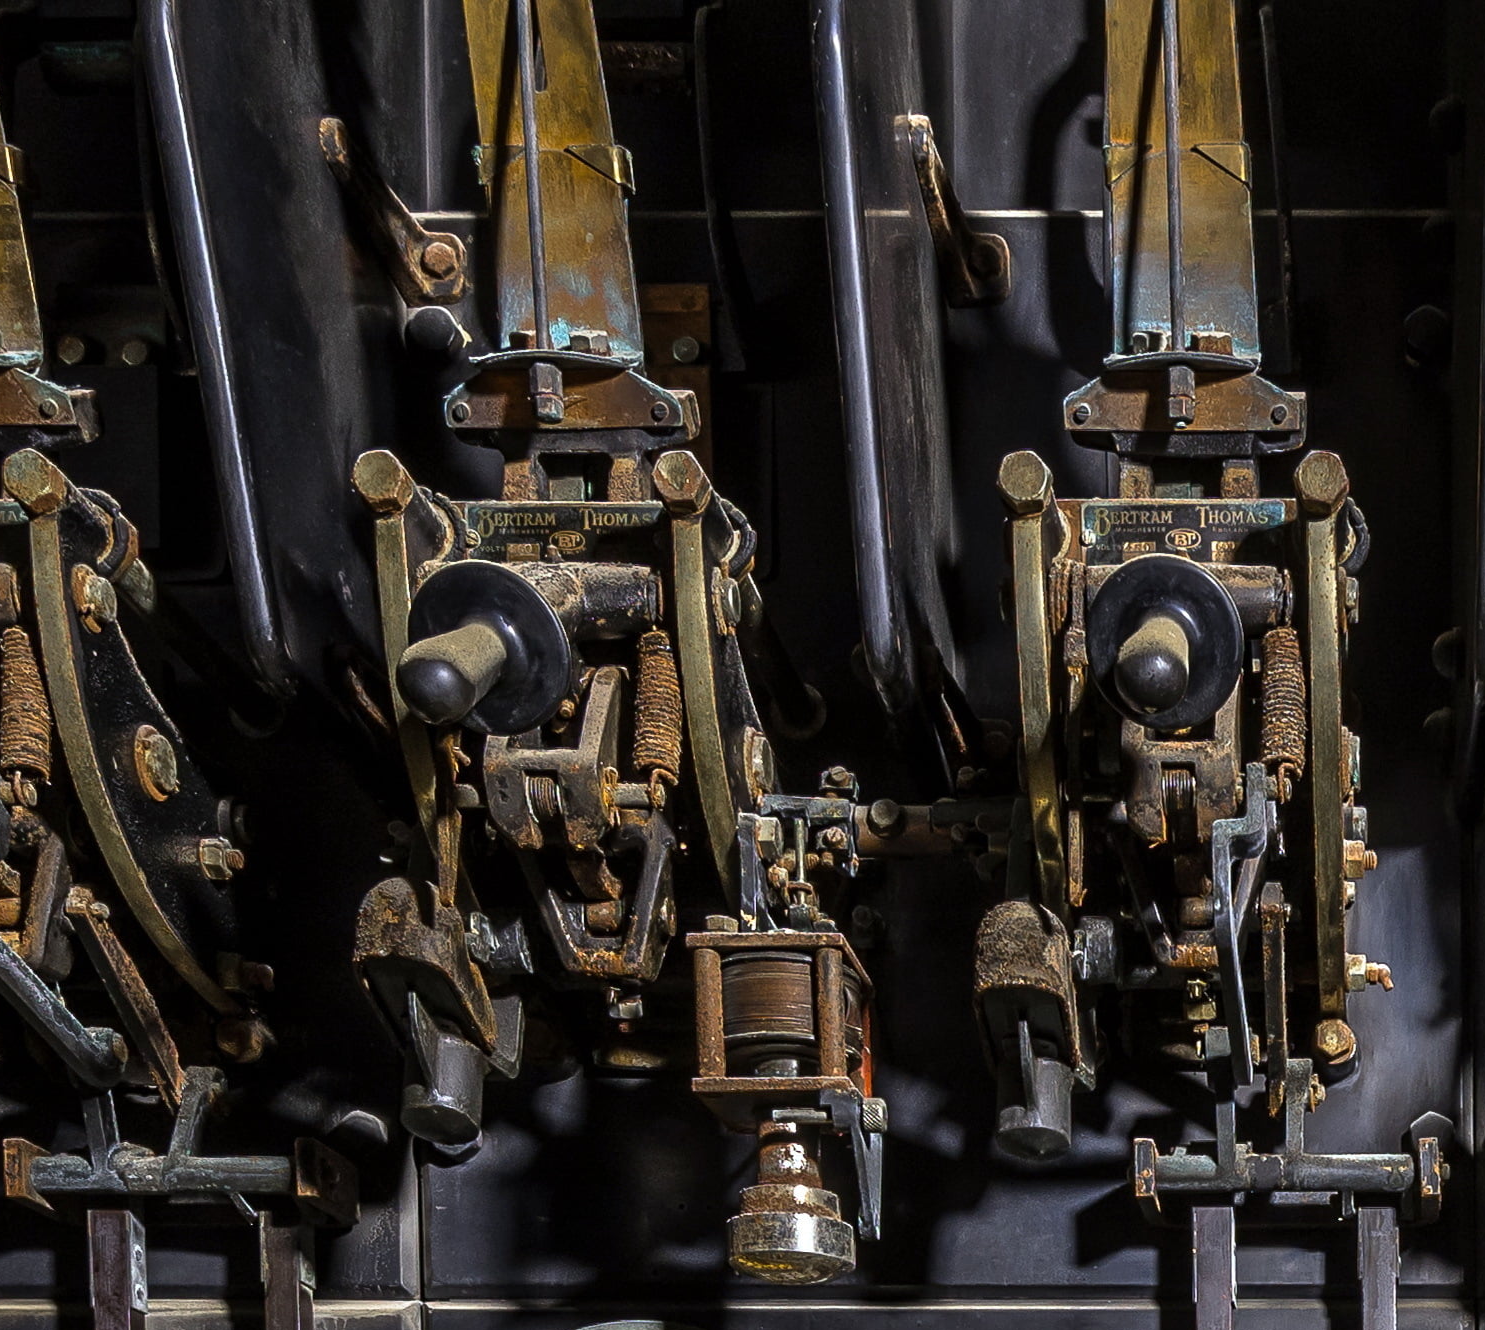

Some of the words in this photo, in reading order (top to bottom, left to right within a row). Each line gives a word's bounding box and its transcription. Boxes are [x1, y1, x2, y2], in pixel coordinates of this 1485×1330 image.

[478, 509, 557, 538] BERTRAM
[579, 508, 652, 530] THOMAS
[1096, 508, 1173, 536] BERTRAM
[1196, 506, 1268, 528] THOMAS
